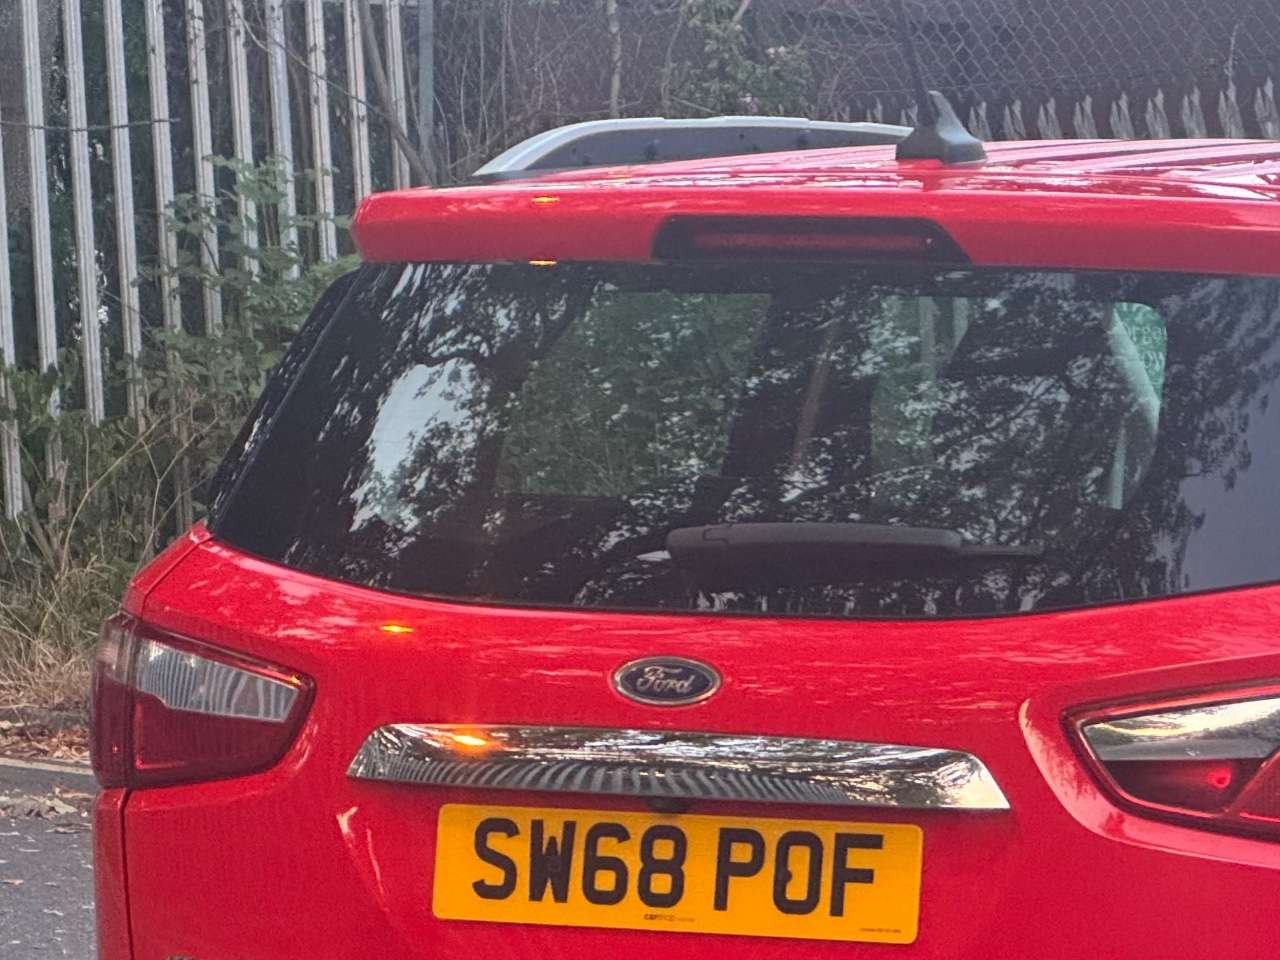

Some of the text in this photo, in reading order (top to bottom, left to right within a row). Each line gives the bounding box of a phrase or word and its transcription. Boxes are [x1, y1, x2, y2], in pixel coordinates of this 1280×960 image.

[637, 665, 696, 694] Ford
[471, 816, 884, 918] SW68 POF
